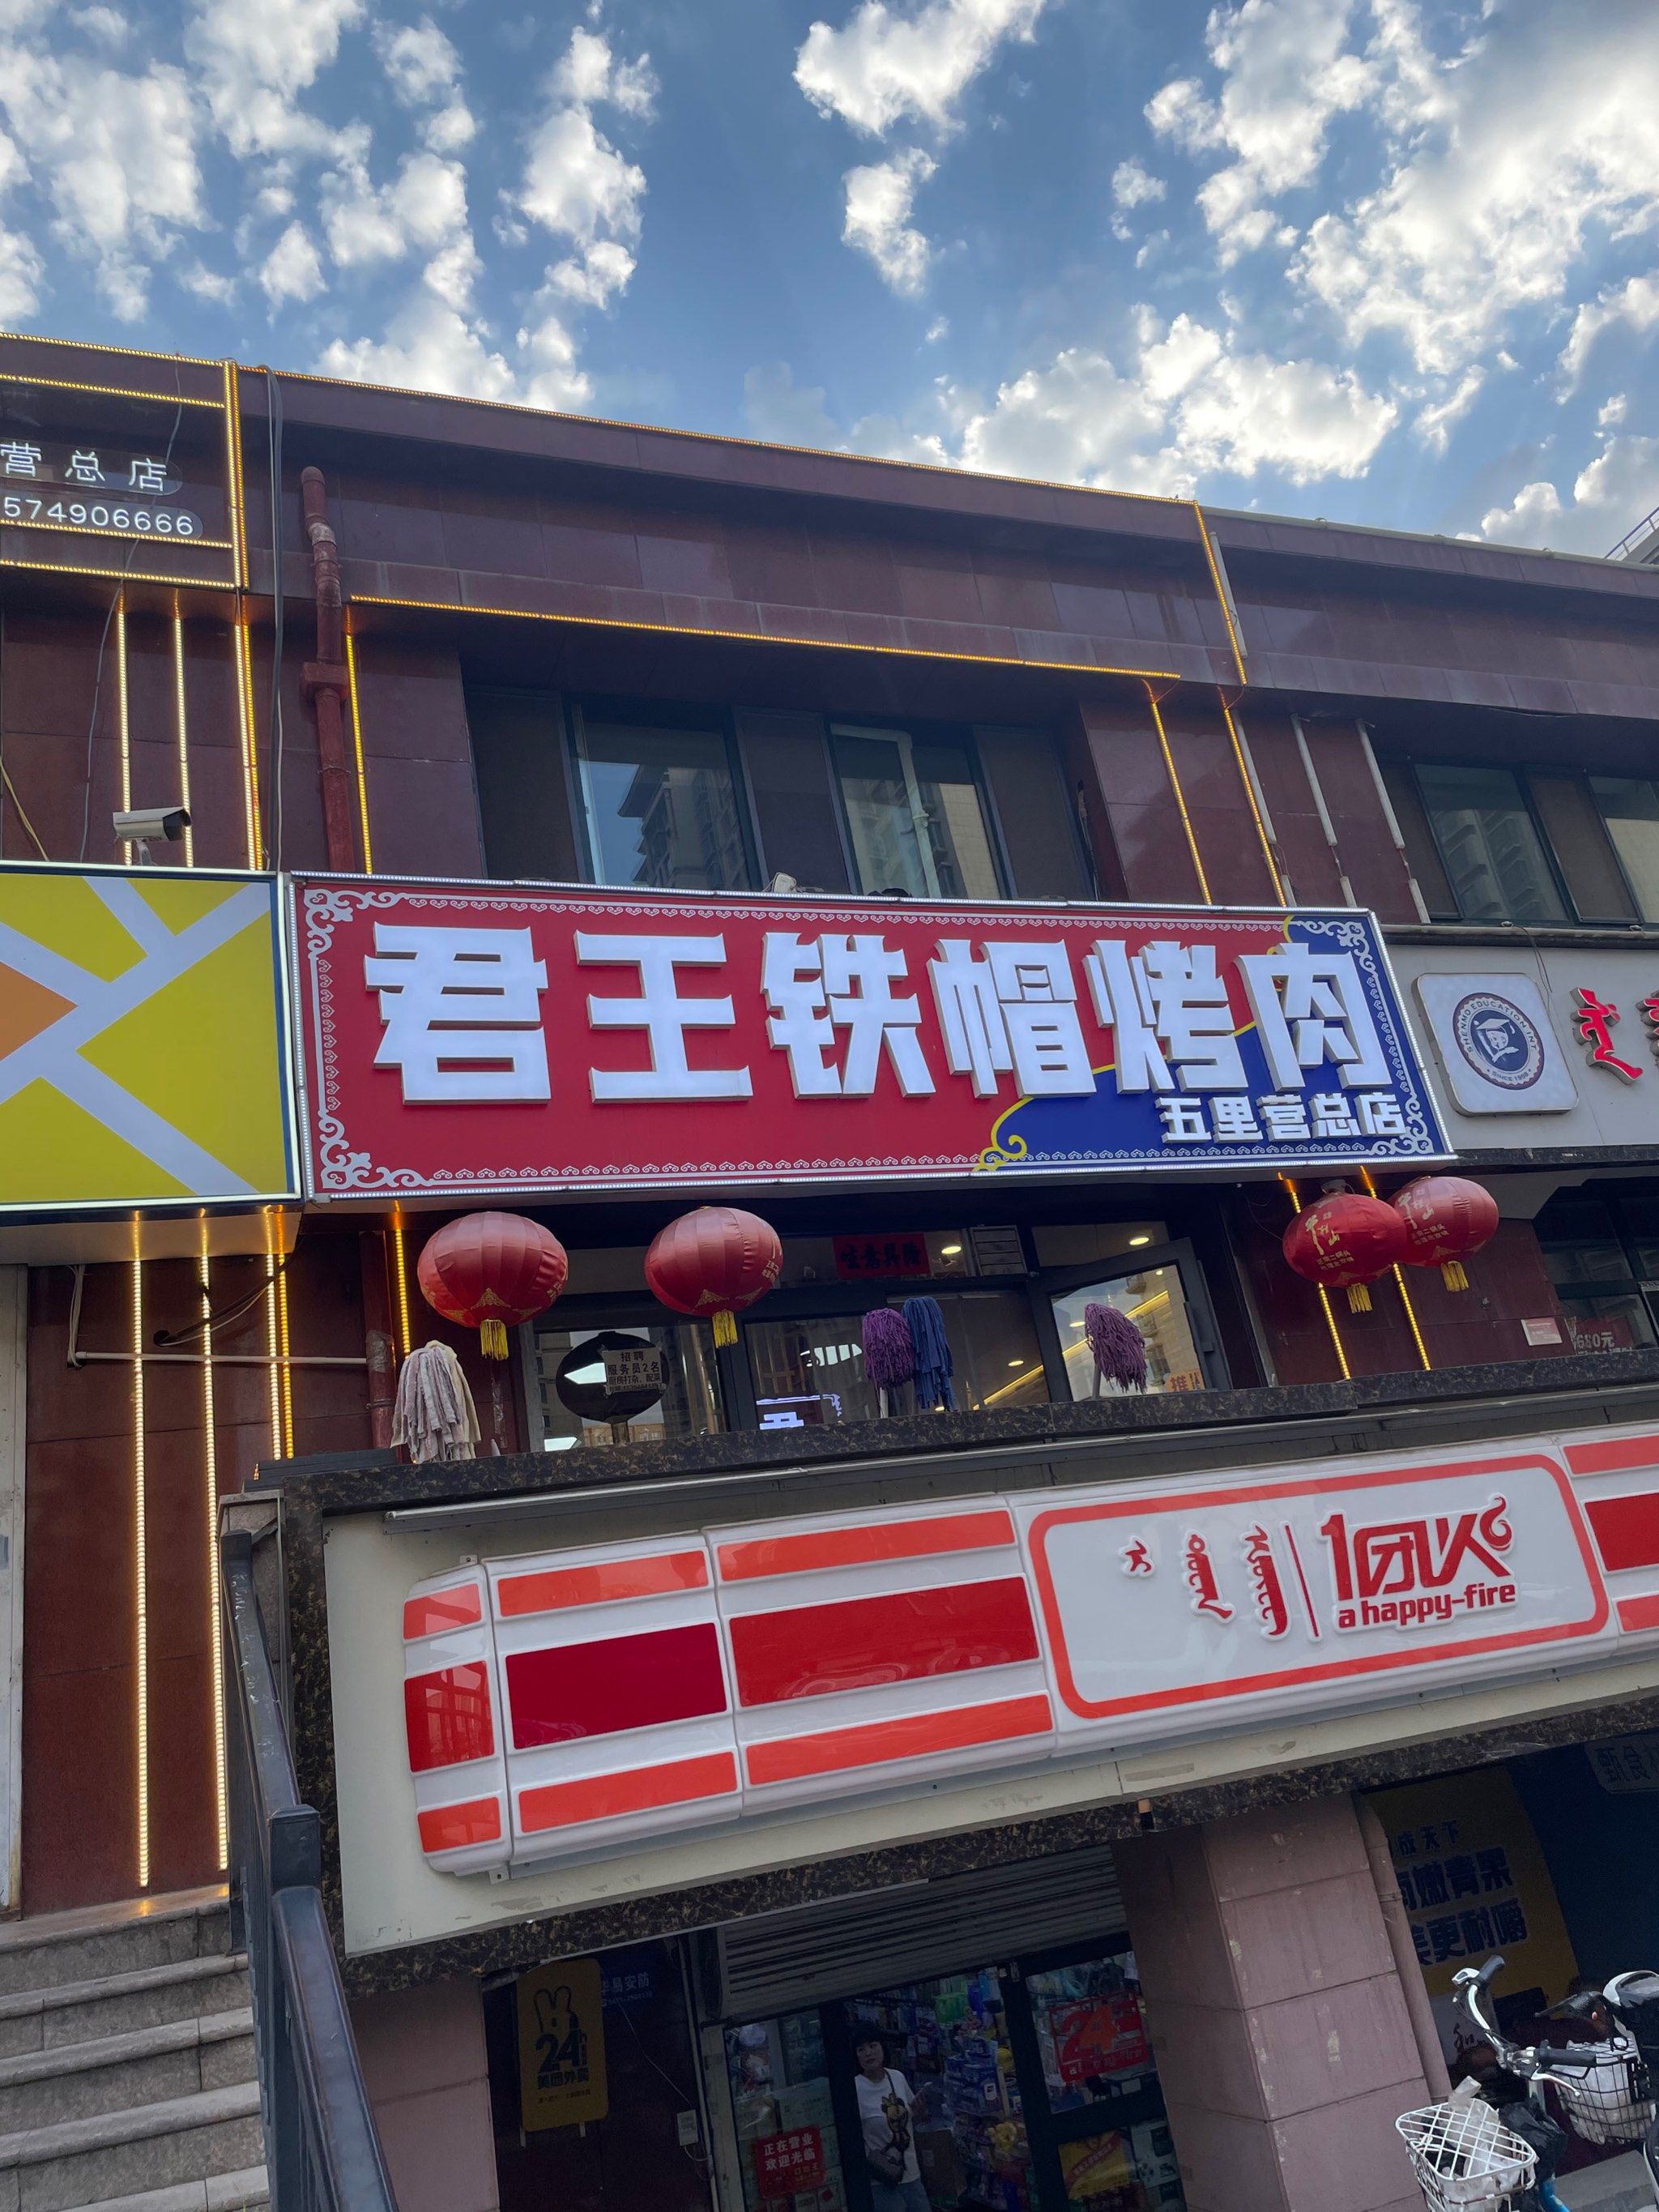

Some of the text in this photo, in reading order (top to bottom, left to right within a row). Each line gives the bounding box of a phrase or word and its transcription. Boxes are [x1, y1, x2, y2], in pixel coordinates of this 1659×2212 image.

[0, 442, 167, 492] 营总店
[3, 497, 194, 536] 574906666
[364, 921, 1392, 1104] 君王铁帽烤肉
[1461, 1008, 1473, 1053] SHENMO
[1472, 1000, 1527, 1028] EDUCATION
[1492, 1070, 1513, 1082] SINCE
[1155, 1091, 1407, 1143] 五里营总店
[608, 1360, 659, 1376] 服务员2名
[620, 1351, 645, 1362] 招聘
[1338, 1582, 1516, 1629] a happy-fire
[763, 2132, 814, 2157] 正在营业
[765, 2147, 816, 2171] 欢迎光临
